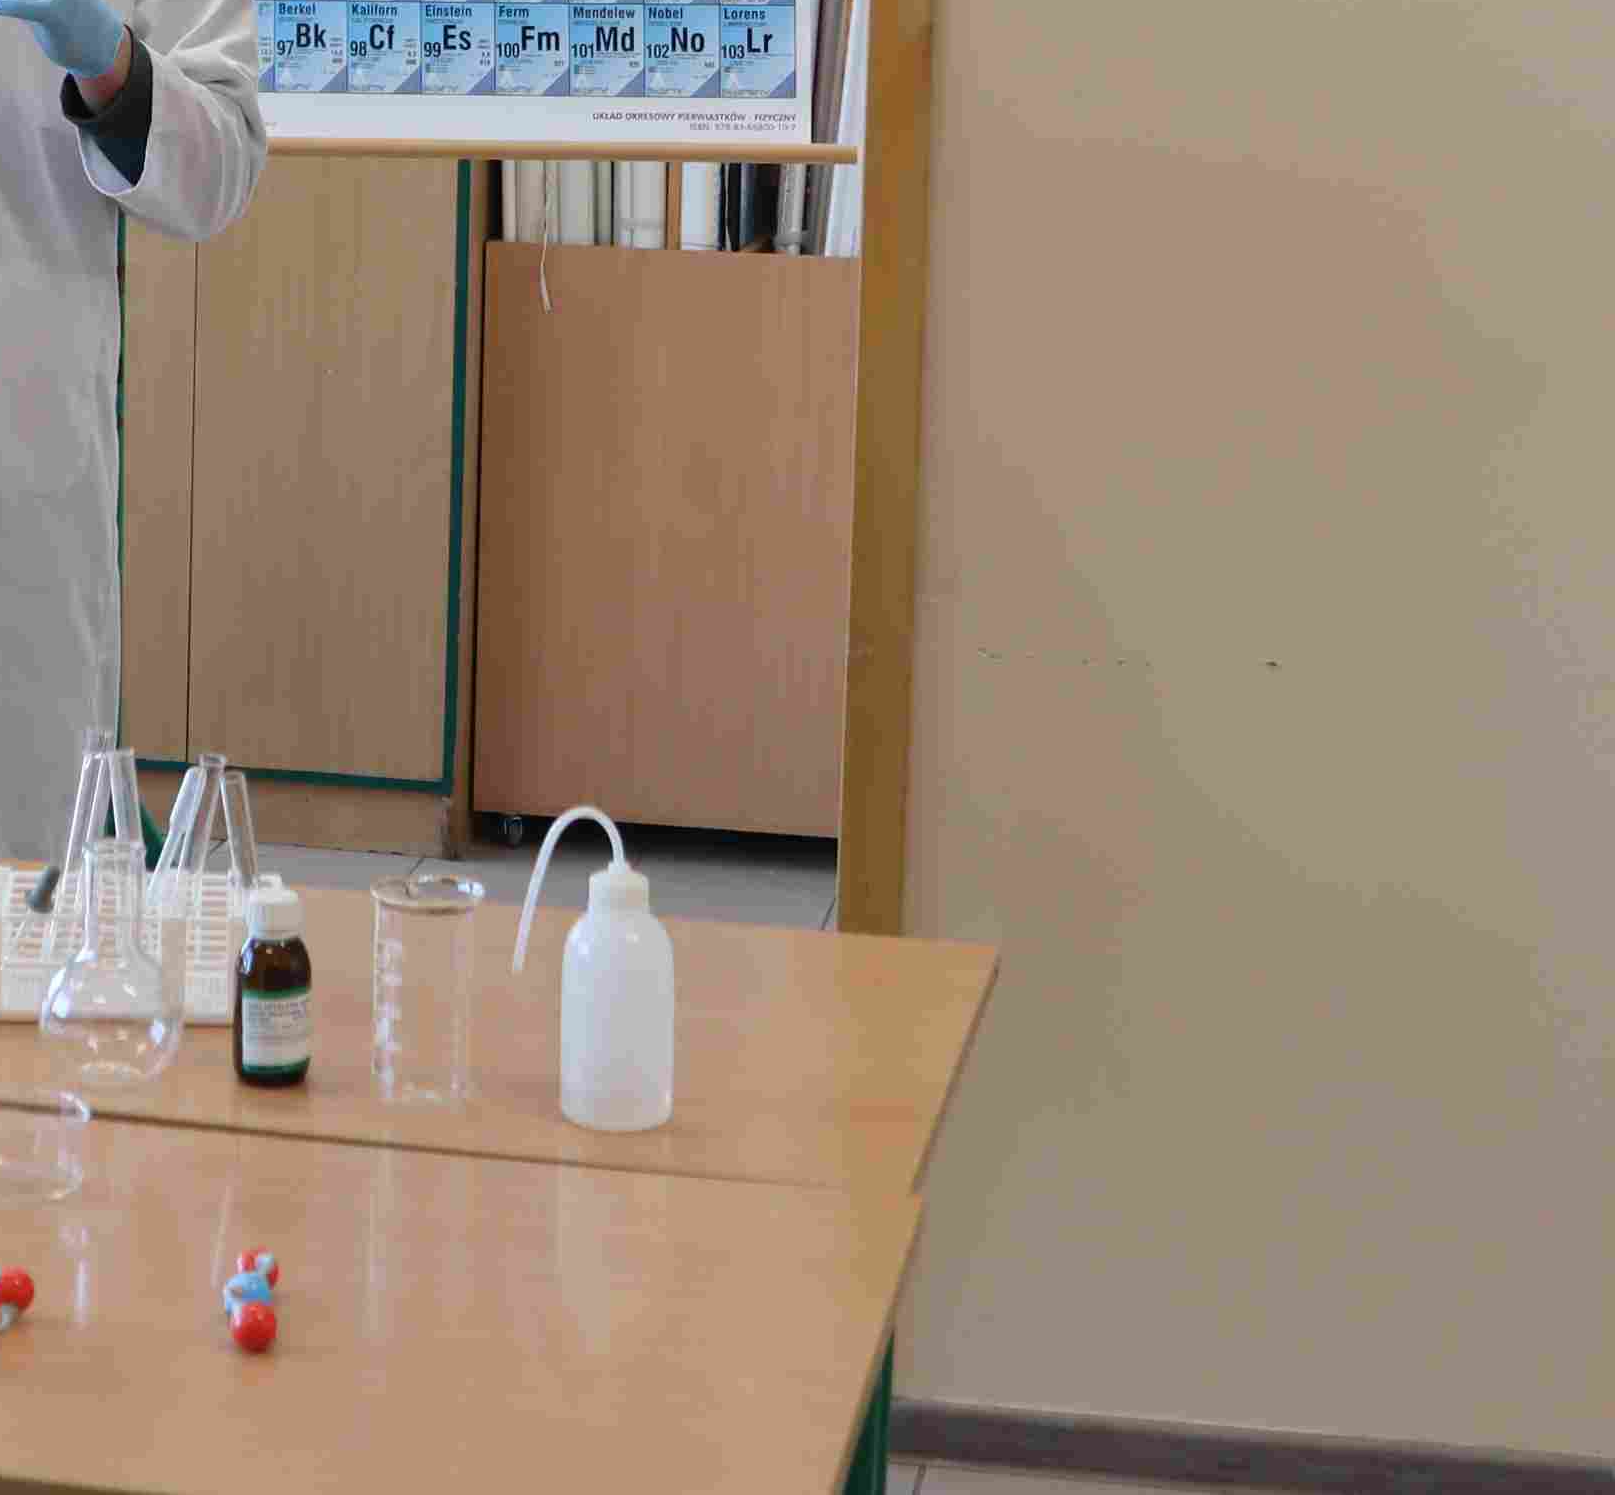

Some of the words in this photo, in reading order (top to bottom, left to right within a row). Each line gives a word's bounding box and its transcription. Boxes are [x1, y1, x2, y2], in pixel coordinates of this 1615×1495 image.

[296, 23, 326, 48] Bk
[369, 24, 394, 50] Cf
[443, 24, 471, 50] Es
[521, 26, 560, 51] Fm
[596, 26, 634, 52] Md
[671, 27, 705, 52] No
[747, 27, 773, 53] Lr
